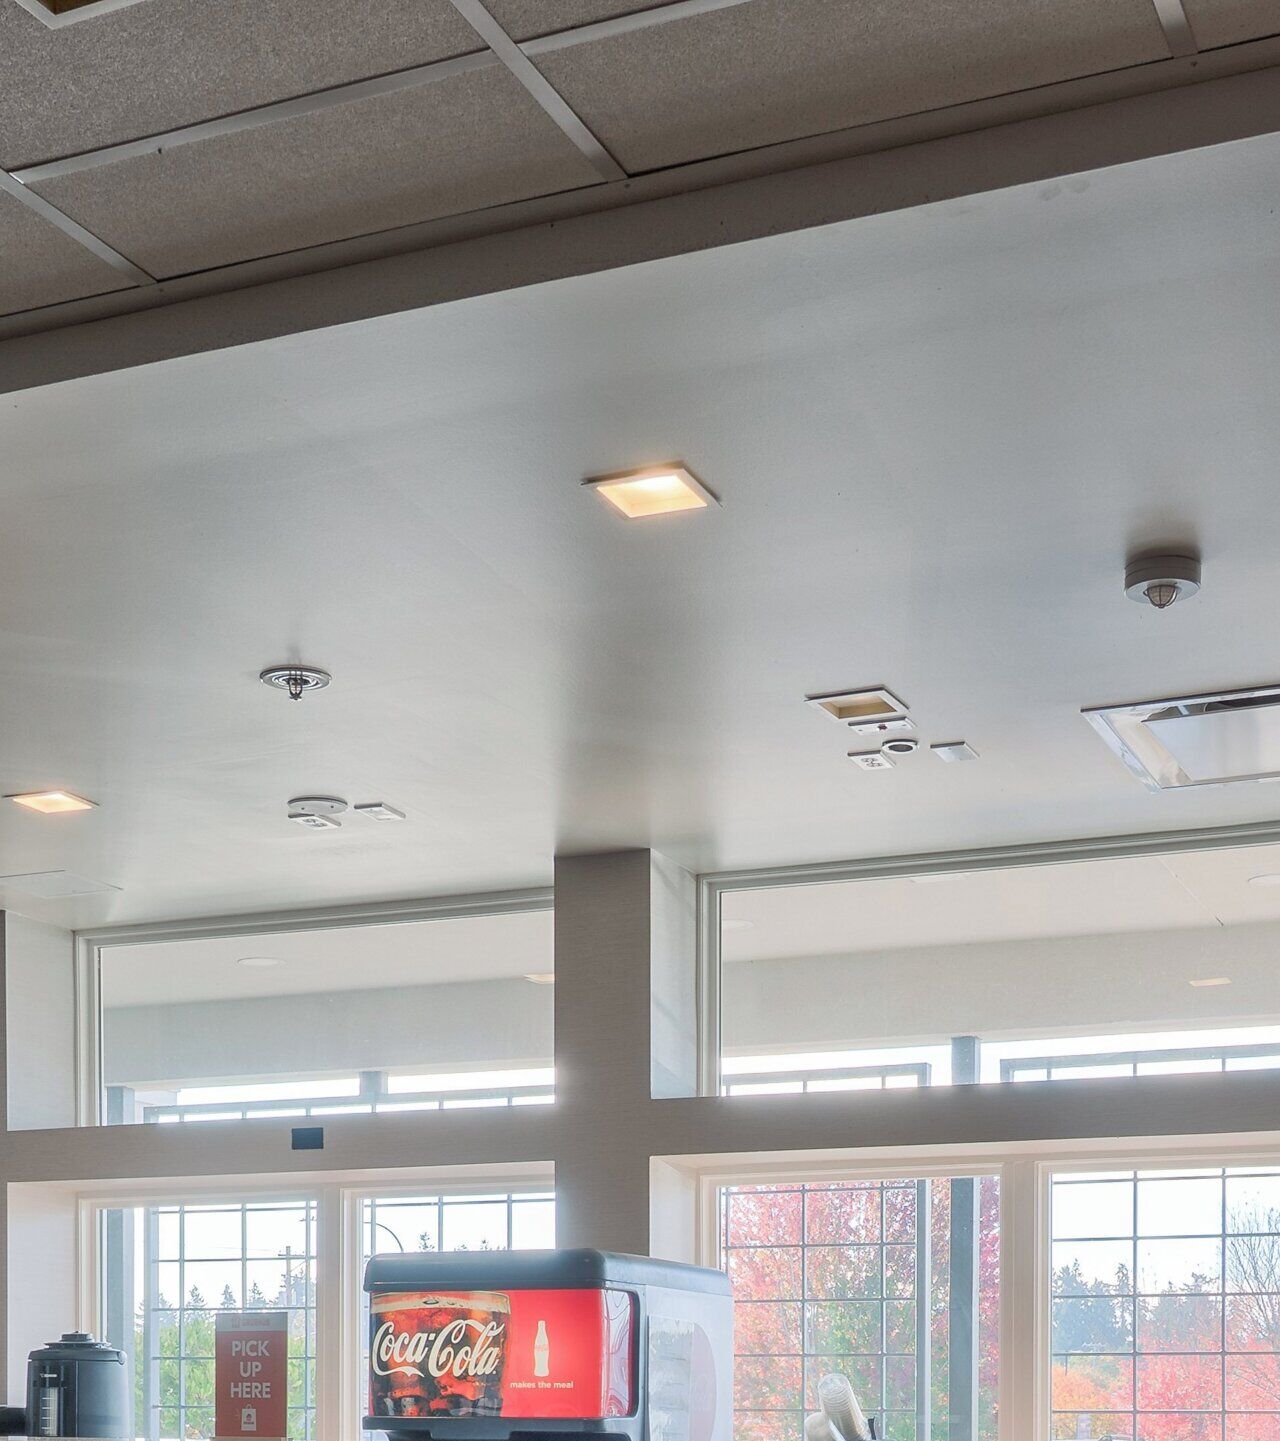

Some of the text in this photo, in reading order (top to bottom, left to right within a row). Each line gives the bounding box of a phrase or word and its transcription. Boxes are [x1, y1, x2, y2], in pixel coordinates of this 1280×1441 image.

[231, 1340, 270, 1357] PICK
[372, 1319, 505, 1378] Coca-Cola
[240, 1361, 262, 1377] UP
[230, 1382, 271, 1398] HERE
[509, 1381, 574, 1389] makes the meal
